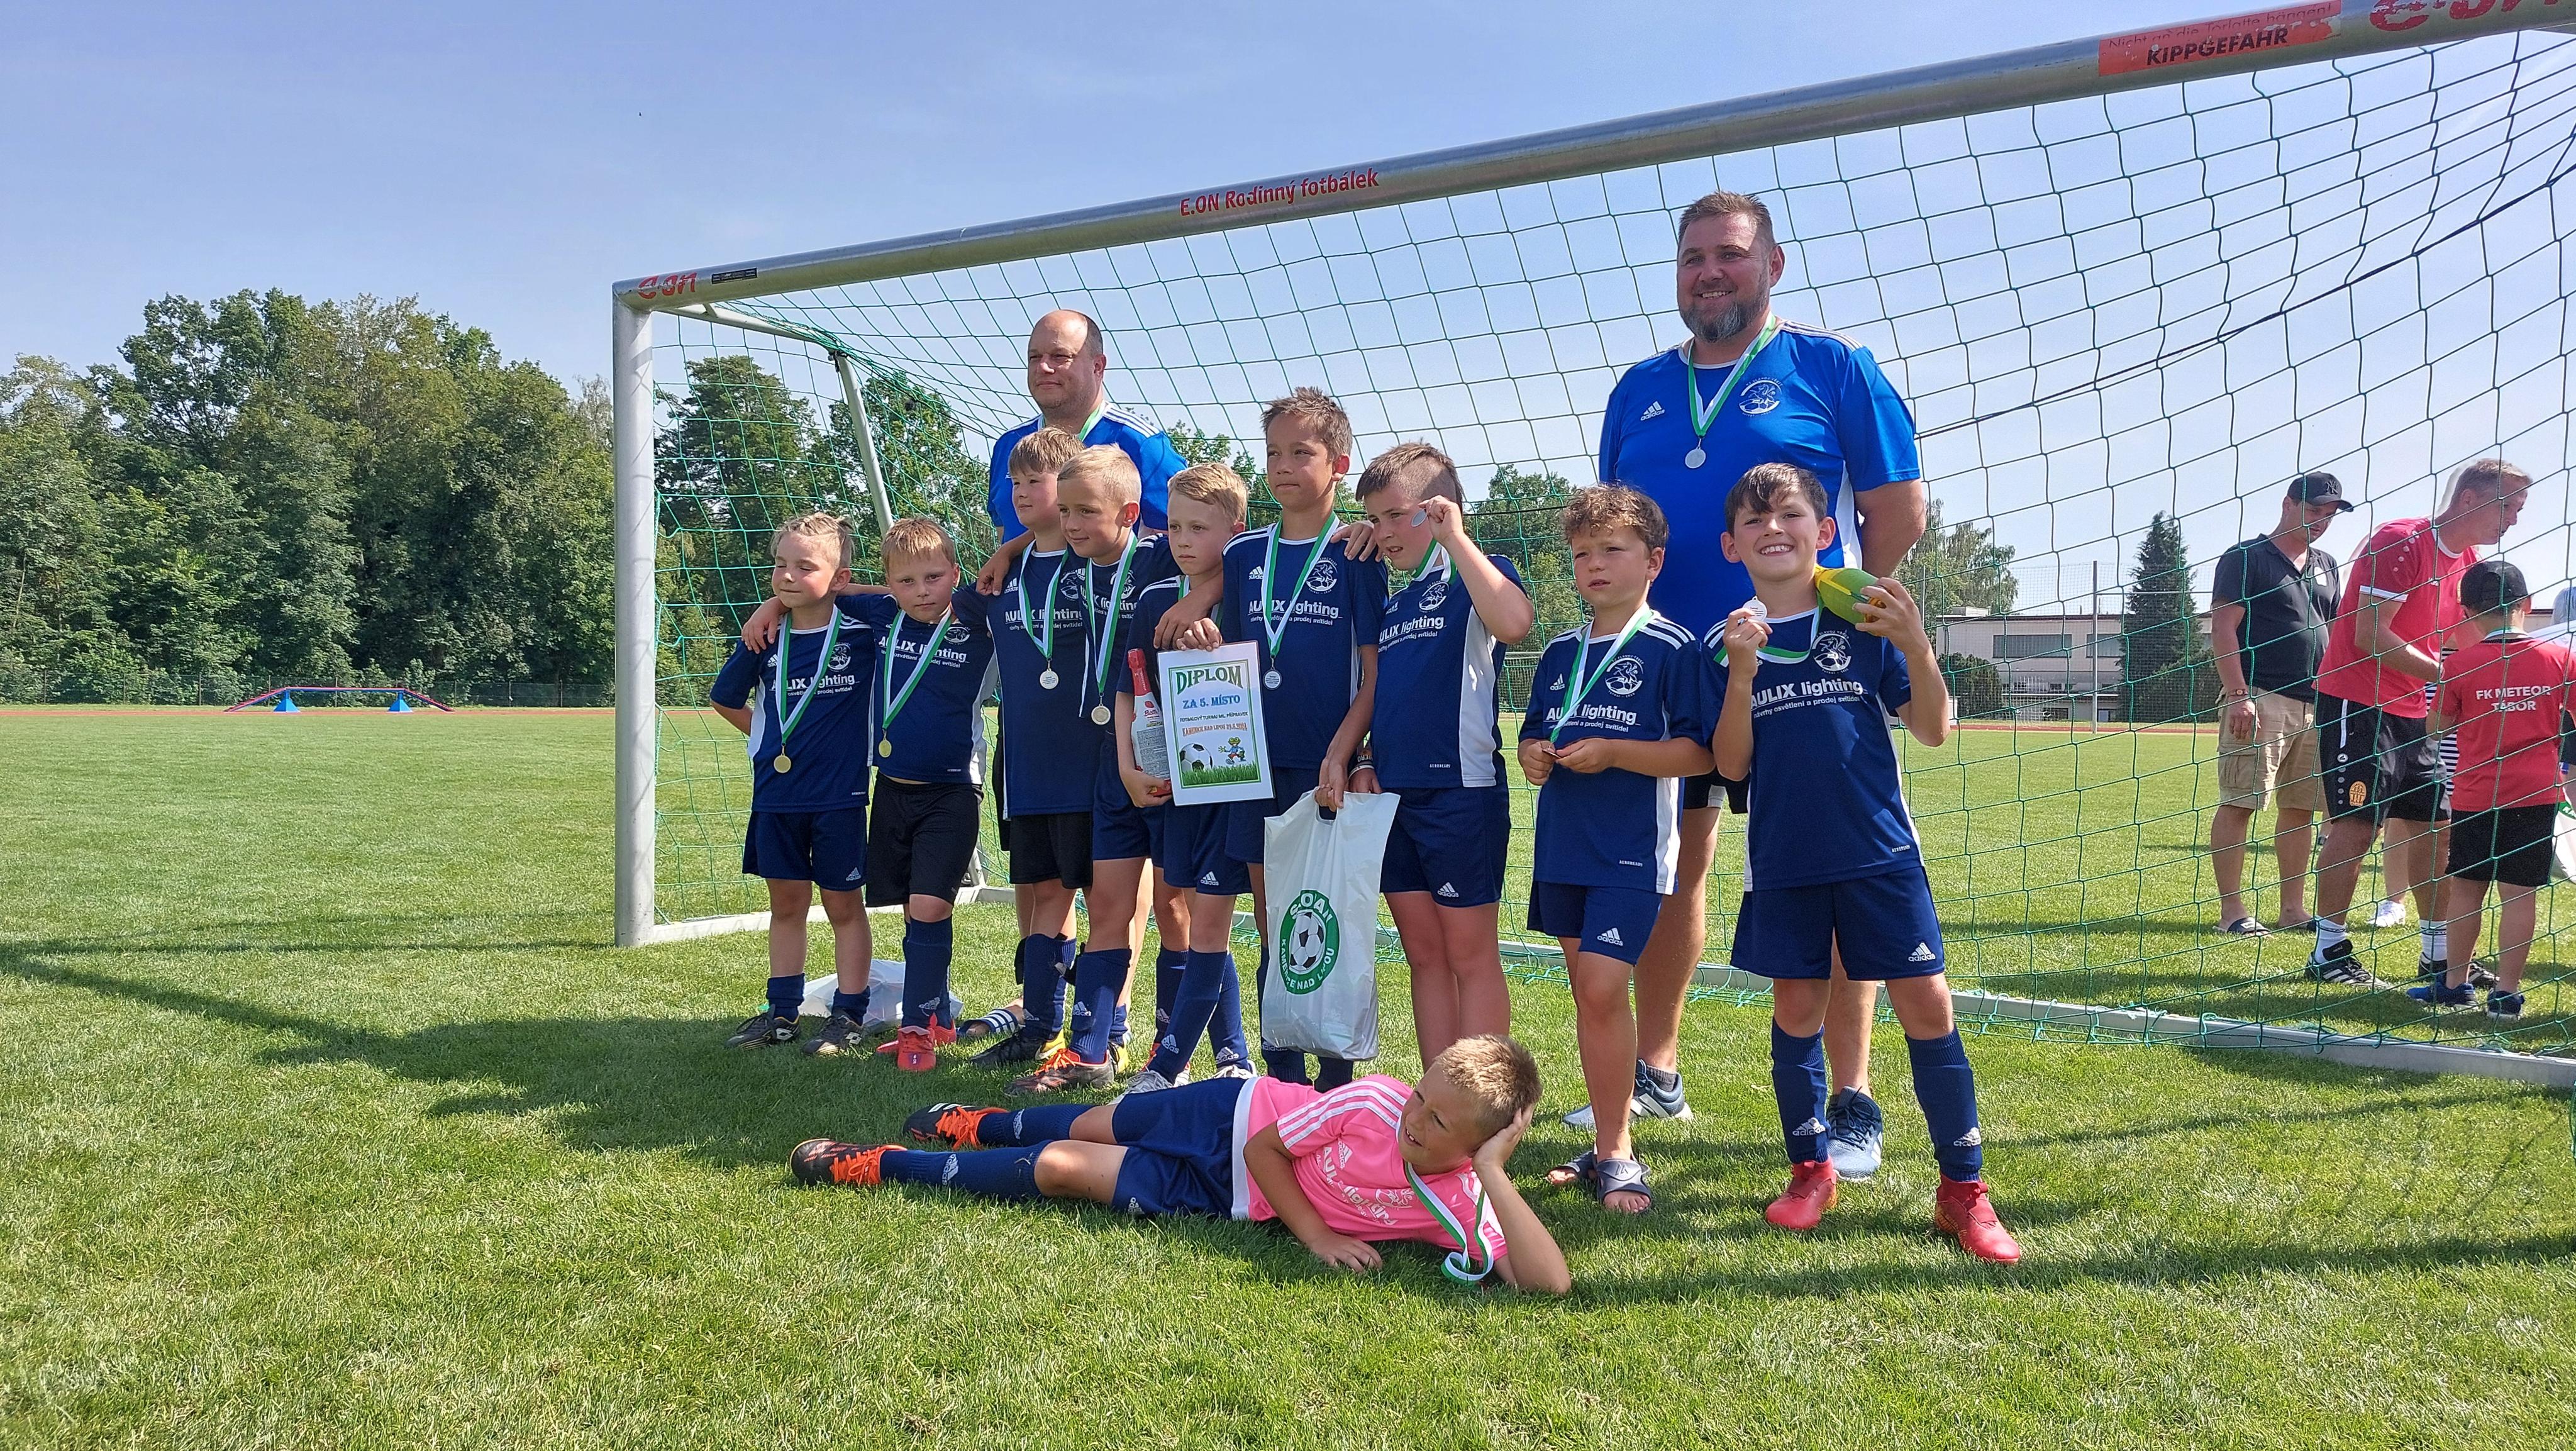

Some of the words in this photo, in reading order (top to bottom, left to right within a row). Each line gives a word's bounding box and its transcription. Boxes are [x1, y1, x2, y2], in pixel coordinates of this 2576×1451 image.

[2146, 28, 2289, 65] KIPPGEFAHR
[1179, 195, 1219, 216] E.ON
[1225, 180, 1296, 209] Rodinný
[1301, 167, 1379, 197] fotbálek
[1640, 409, 1665, 421] adidas
[1401, 614, 1445, 634] lighting
[1175, 665, 1244, 695] DIPLOM
[1751, 683, 1797, 709] AULIX
[1801, 678, 1863, 696] lighting
[1813, 694, 1837, 704] prodej
[2475, 689, 2493, 700] FK
[2495, 686, 2551, 698] METEOR
[1182, 699, 1198, 709] ZA
[1199, 697, 1209, 707] 5.
[1211, 694, 1241, 706] MÍSTO
[2491, 699, 2536, 713] TÁBOR
[1581, 704, 1637, 726] lighting
[1584, 721, 1604, 729] prodej
[1605, 723, 1629, 733] svítidel
[1597, 935, 1624, 947] adidas
[1907, 952, 1936, 962] adidas
[1297, 977, 1315, 990] NAD
[1338, 1141, 1346, 1170] adidas
